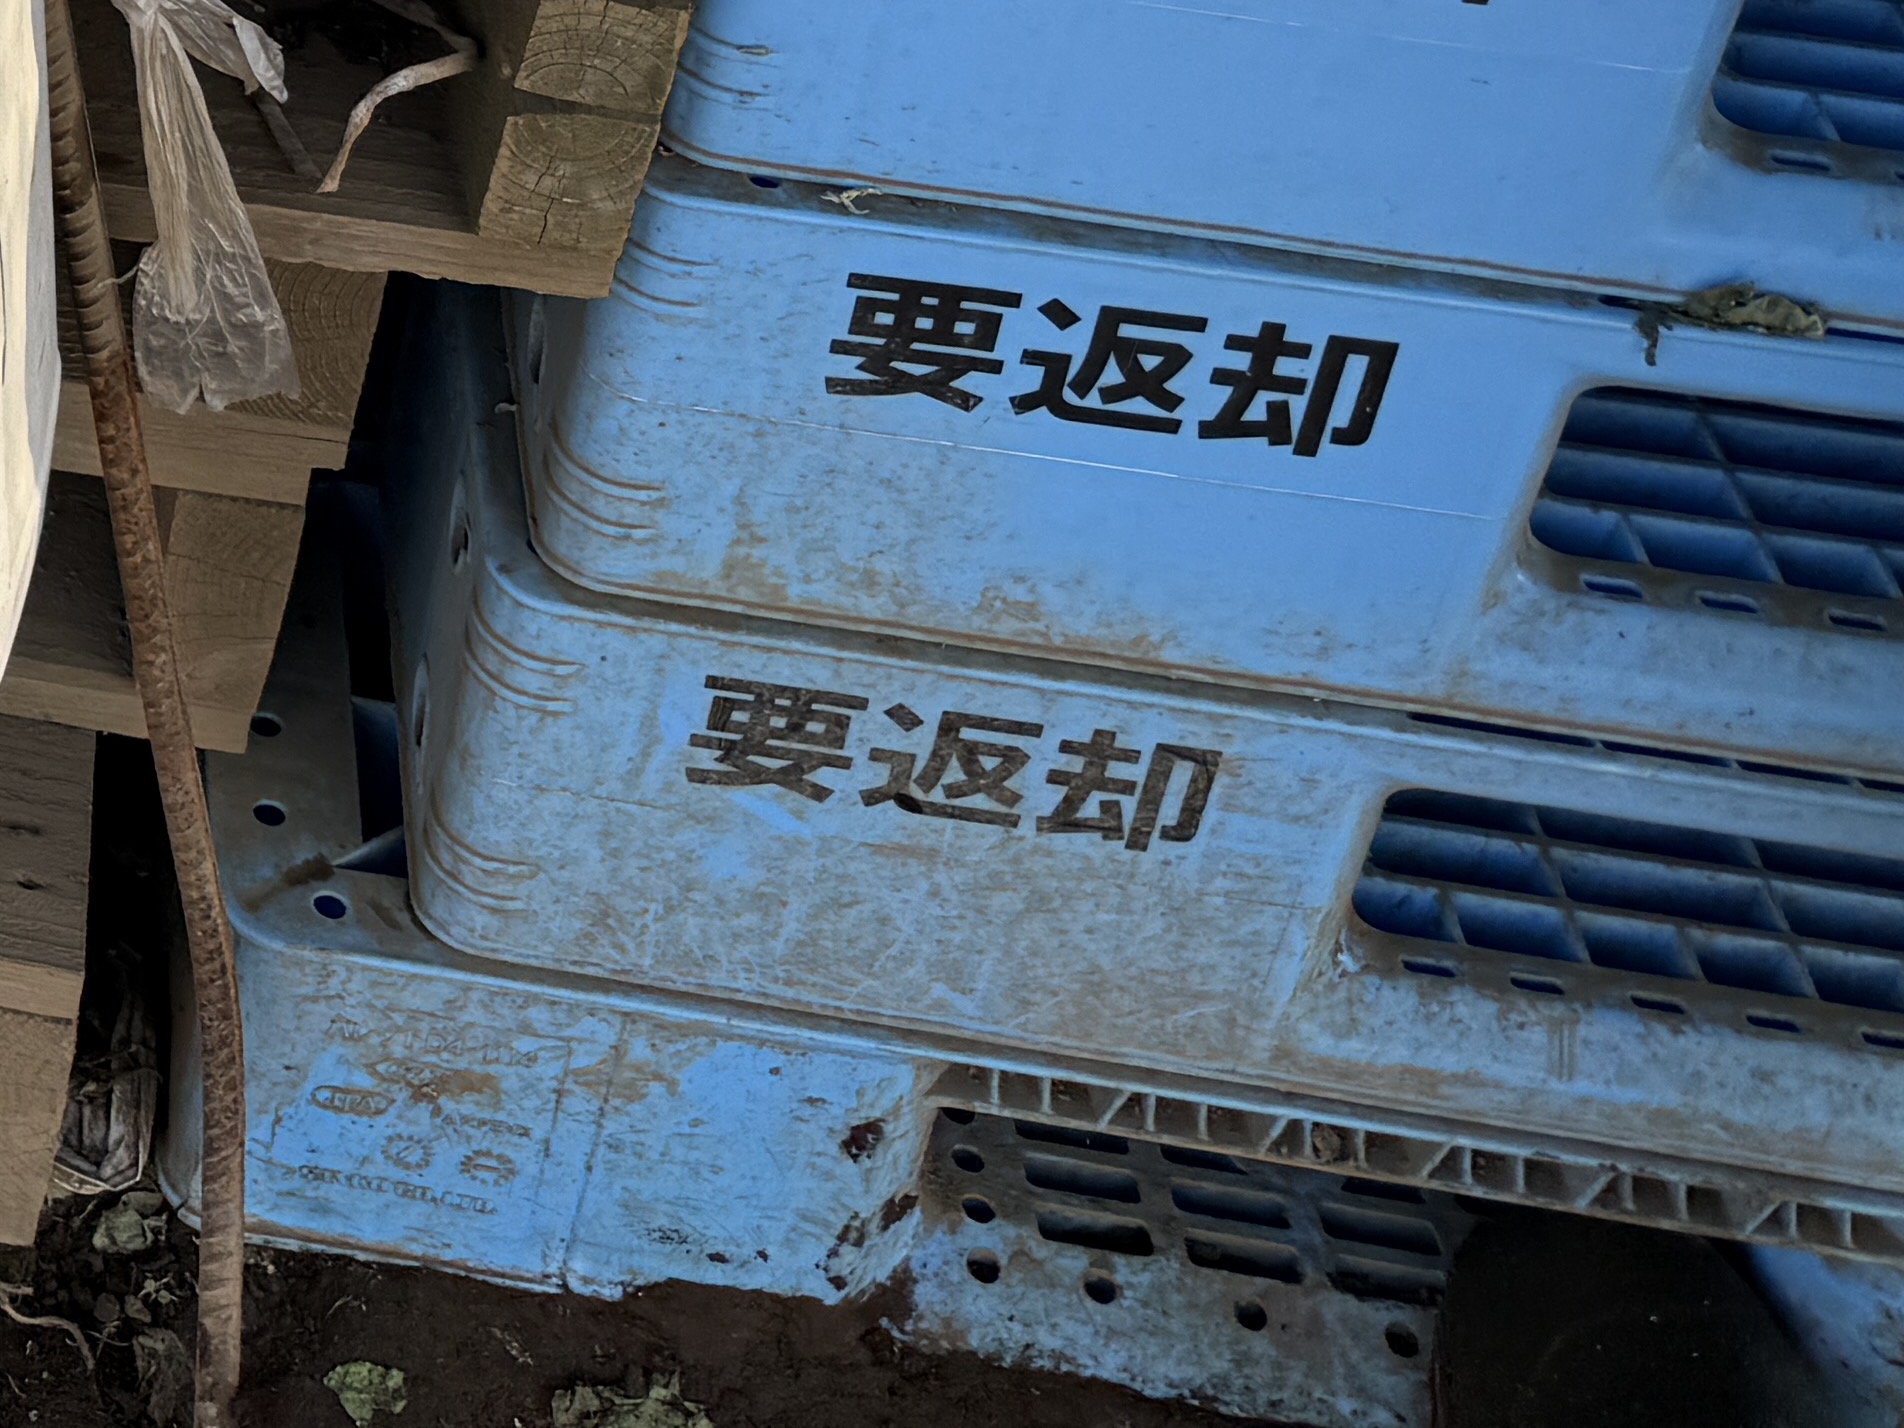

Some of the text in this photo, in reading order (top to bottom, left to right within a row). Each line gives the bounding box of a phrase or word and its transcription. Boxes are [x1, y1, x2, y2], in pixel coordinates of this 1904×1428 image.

[824, 271, 1400, 459] 要返却
[683, 674, 1224, 853] 要返却
